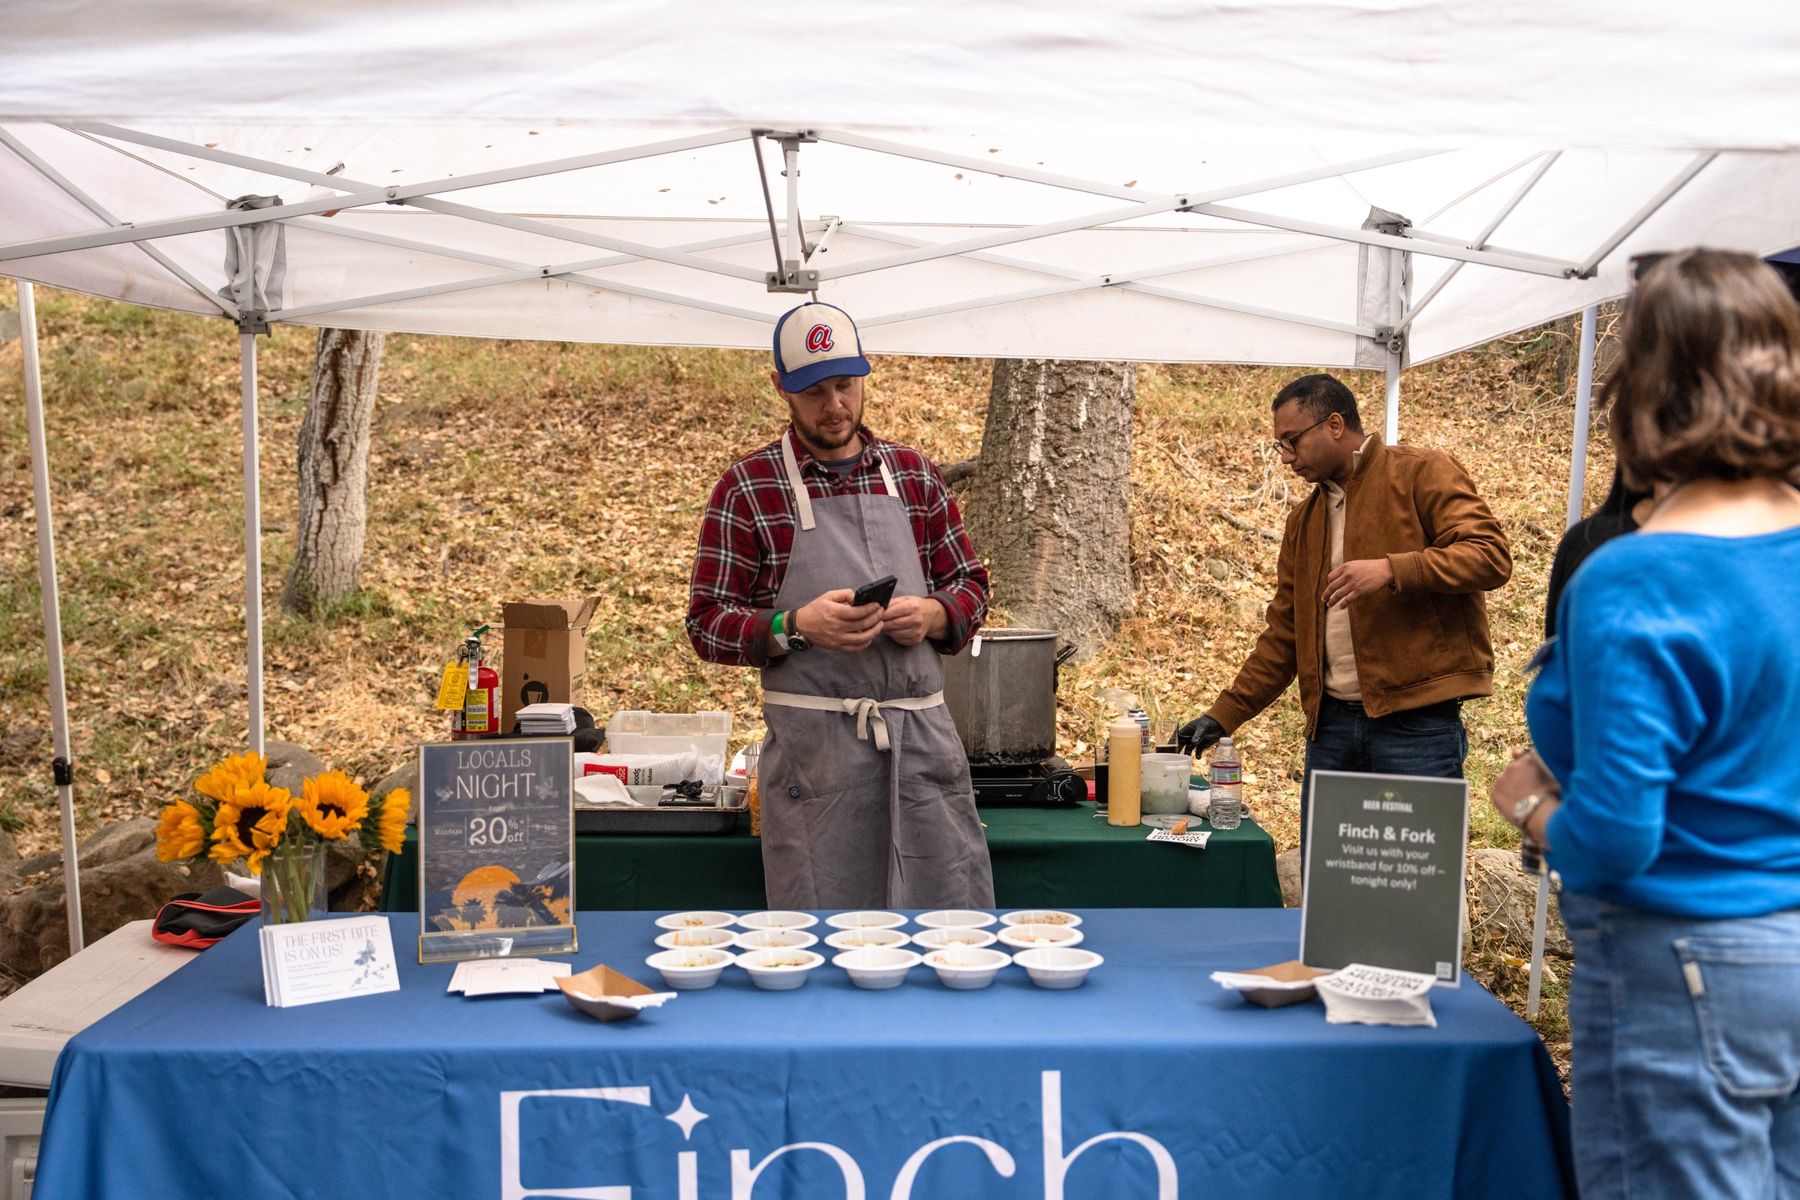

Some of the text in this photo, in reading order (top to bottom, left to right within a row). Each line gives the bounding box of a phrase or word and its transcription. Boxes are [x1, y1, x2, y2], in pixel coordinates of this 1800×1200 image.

[457, 749, 532, 769] LOCALS
[456, 772, 536, 799] NIGHT
[633, 767, 642, 786] Spoo
[1362, 799, 1381, 810] BEER
[1339, 823, 1436, 844] Finch & Fork
[1342, 844, 1430, 860] Visit us with your
[1325, 859, 1377, 871] wristband
[1379, 861, 1394, 872] for
[1397, 863, 1419, 874] 10%
[1420, 866, 1436, 876] off
[1351, 875, 1417, 890] tonight only!
[282, 924, 380, 949] THE FIRST BITE
[284, 943, 345, 963] IS ON US!
